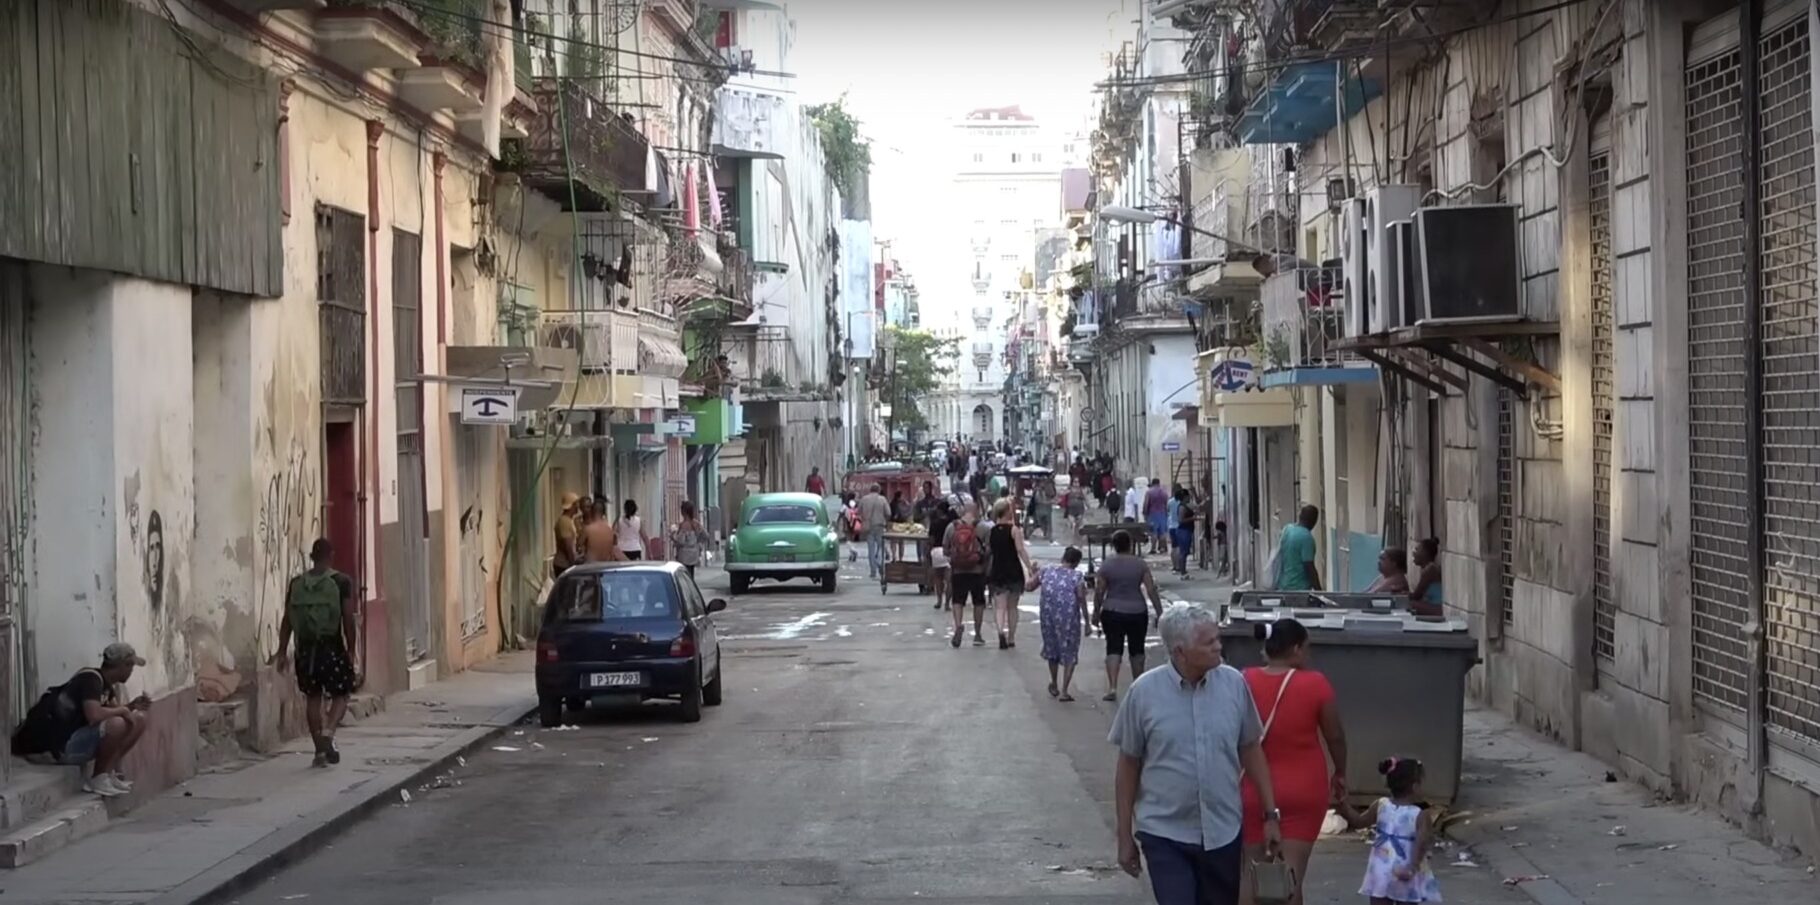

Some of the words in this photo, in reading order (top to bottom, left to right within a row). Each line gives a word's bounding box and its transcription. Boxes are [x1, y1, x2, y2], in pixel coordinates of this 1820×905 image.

[597, 674, 603, 685] P
[605, 674, 622, 685] 177
[623, 673, 639, 685] 993
